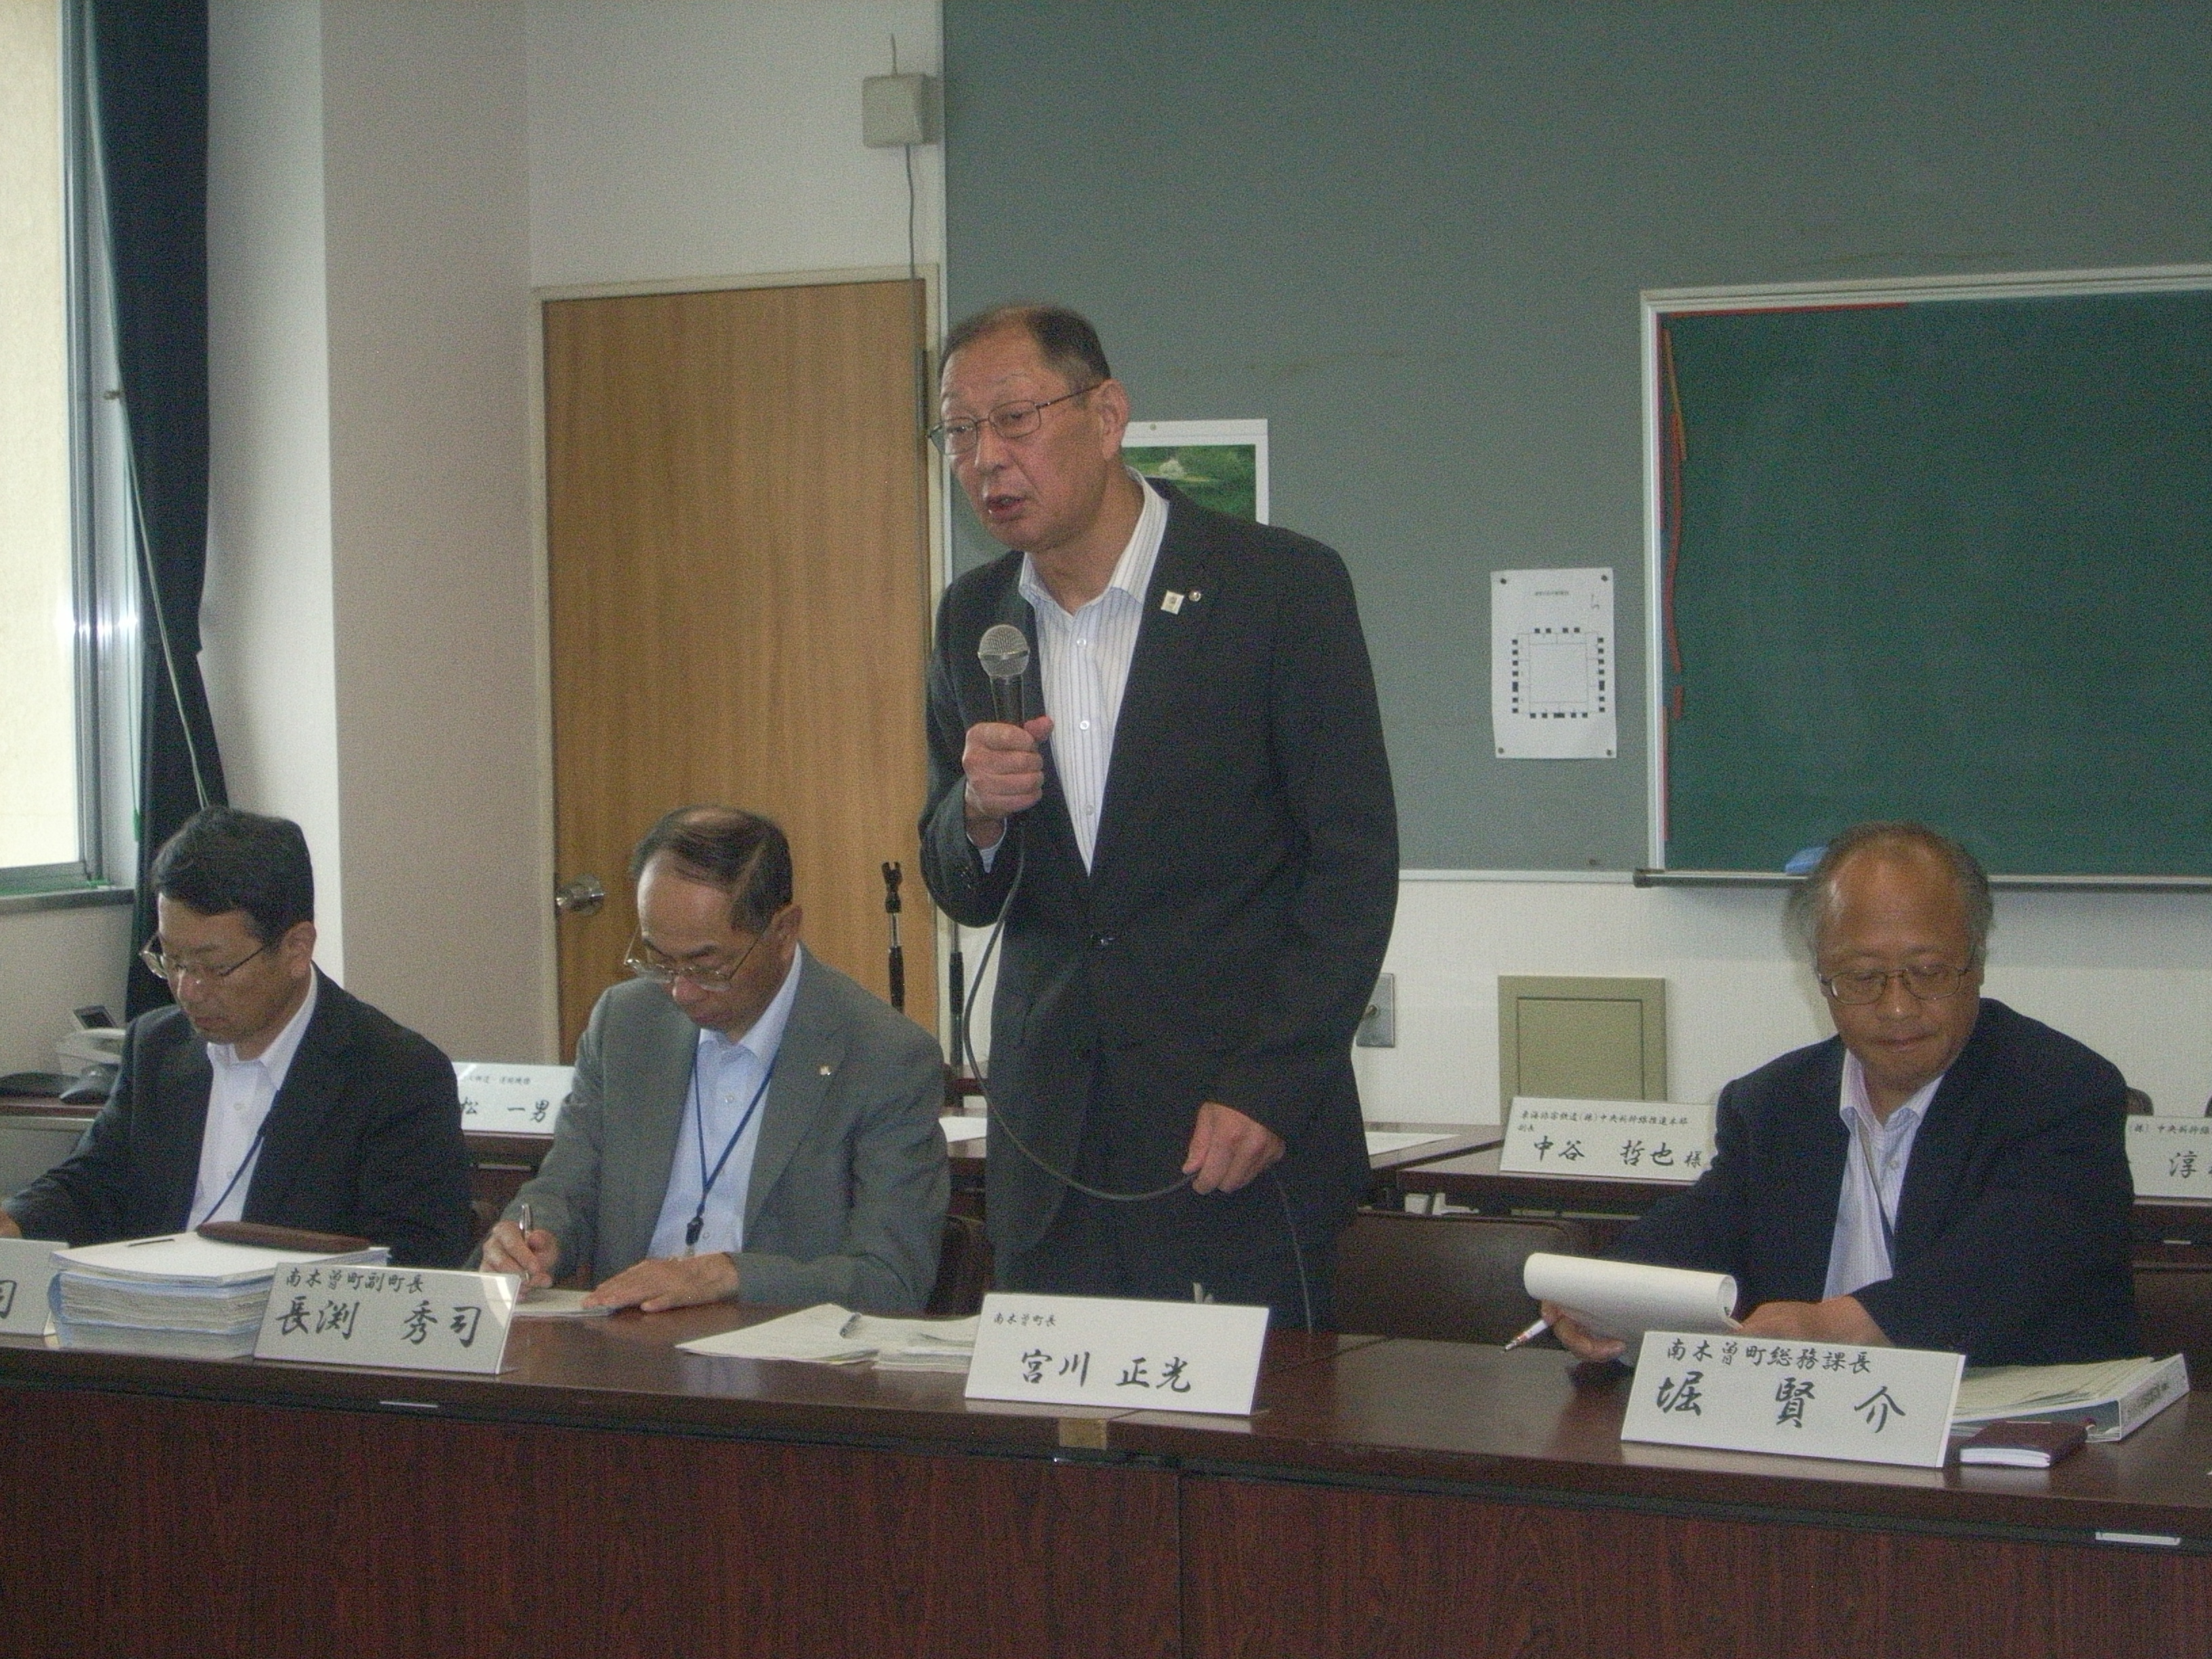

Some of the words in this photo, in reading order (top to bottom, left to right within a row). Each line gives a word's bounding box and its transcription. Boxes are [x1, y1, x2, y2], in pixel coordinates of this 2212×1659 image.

[508, 1099, 550, 1124] 一男
[1534, 1135, 1585, 1162] 中谷
[2169, 1150, 2212, 1179] 淳
[401, 1300, 482, 1349] 秀司
[1021, 1349, 1090, 1387] 宮川
[1116, 1356, 1191, 1393] 正光
[1656, 1371, 1702, 1416] 堀
